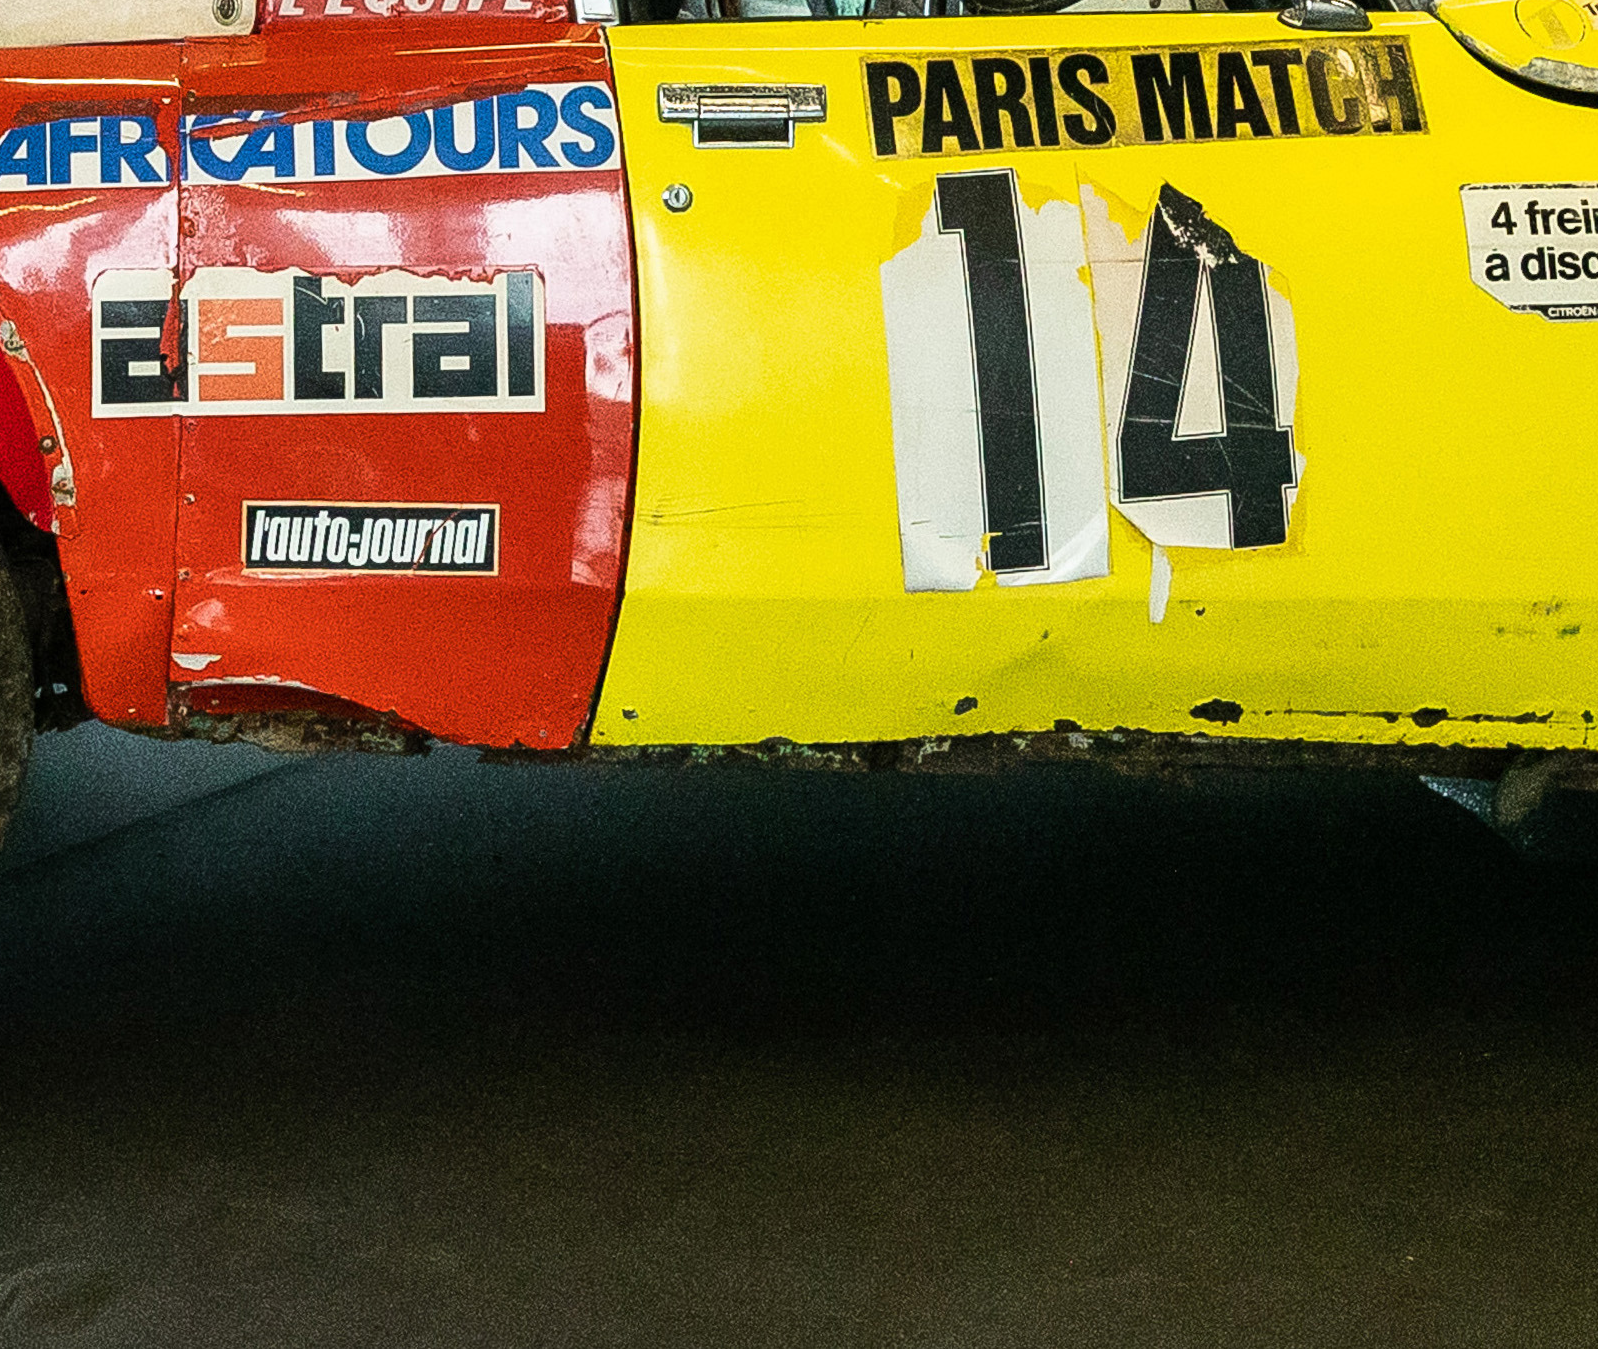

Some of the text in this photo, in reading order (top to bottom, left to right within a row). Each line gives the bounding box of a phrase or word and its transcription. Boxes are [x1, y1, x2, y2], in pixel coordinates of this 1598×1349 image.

[866, 44, 1425, 159] PARIS MATCH
[1490, 201, 1518, 236] 4
[100, 271, 536, 406] astral
[1547, 305, 1598, 318] CITROËN
[934, 166, 1298, 575] 14
[251, 508, 490, 568] l'auto-journal
